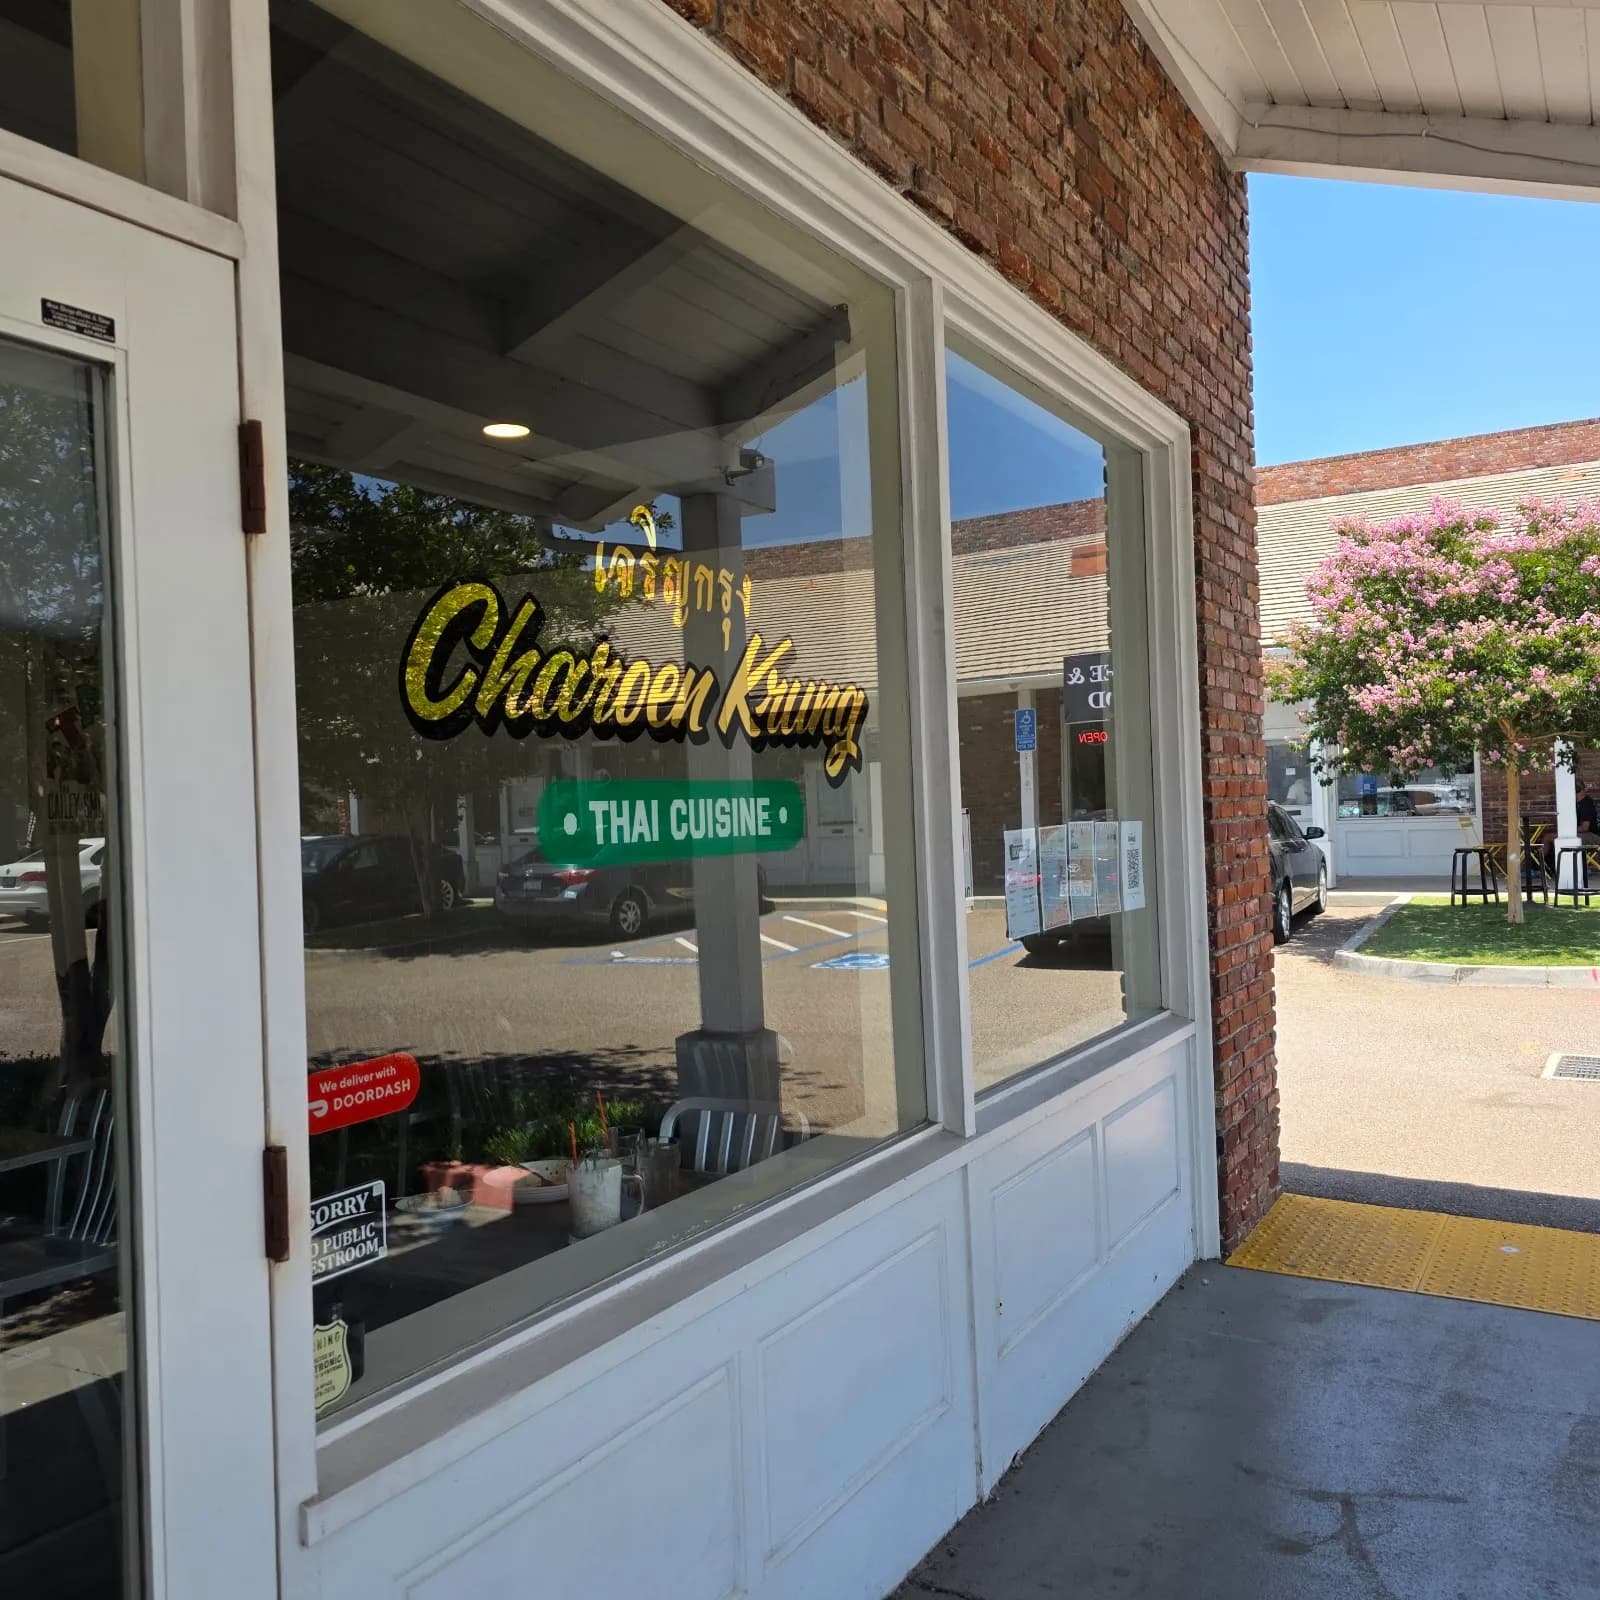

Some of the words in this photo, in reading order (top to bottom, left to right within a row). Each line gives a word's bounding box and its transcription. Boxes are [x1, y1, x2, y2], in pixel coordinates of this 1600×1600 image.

[402, 580, 718, 740] Charoen
[715, 633, 869, 784] Krung
[588, 799, 659, 845] THAI
[670, 797, 772, 840] CUISINE
[320, 1081, 337, 1093] We
[339, 1073, 374, 1089] deliver
[375, 1066, 396, 1079] with
[333, 1079, 411, 1111] DOORDASH
[323, 1222, 376, 1254] PUBLIC
